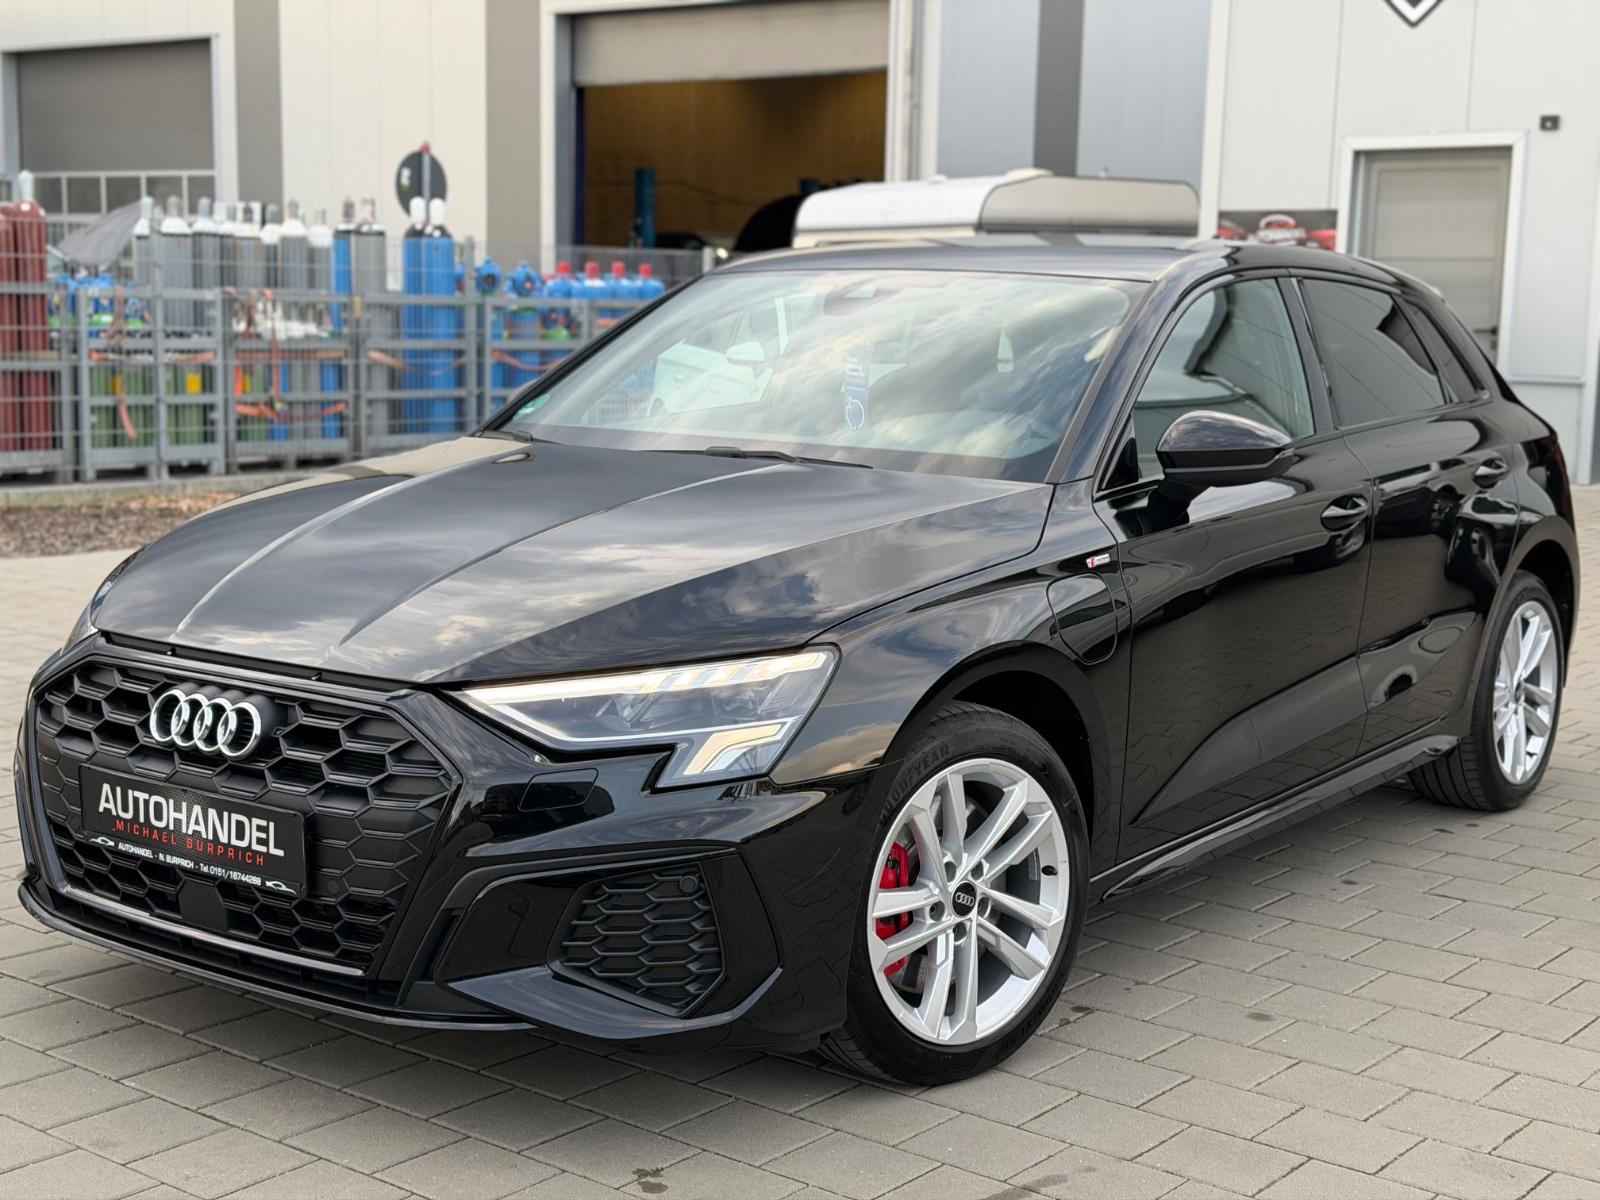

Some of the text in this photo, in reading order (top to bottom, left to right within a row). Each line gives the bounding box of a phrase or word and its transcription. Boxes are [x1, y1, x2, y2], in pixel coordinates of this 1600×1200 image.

[98, 782, 285, 857] AUTOHANDEL
[116, 819, 264, 867] MICHAEL BURPRICH
[118, 842, 154, 859] AUTOHANDEL
[166, 854, 195, 869] BURPRICH
